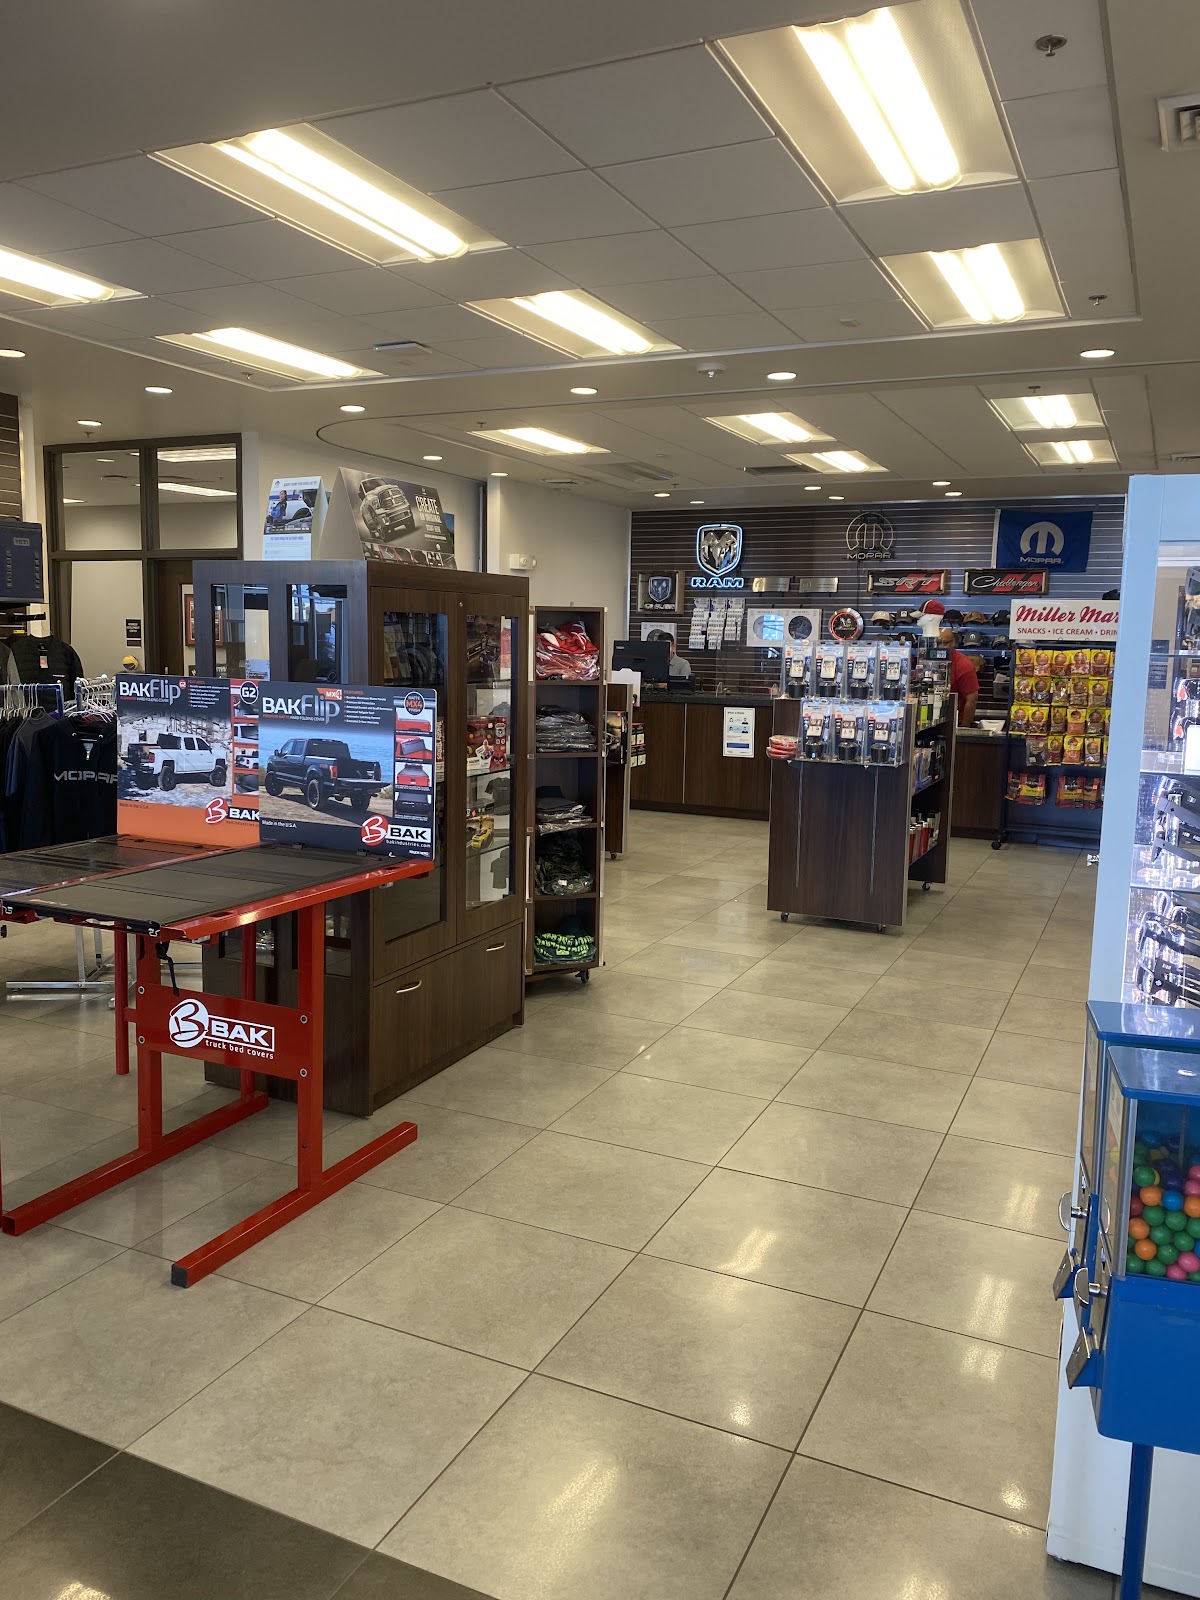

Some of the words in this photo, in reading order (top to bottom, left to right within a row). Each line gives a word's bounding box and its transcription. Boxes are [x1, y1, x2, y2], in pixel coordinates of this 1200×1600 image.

[415, 495, 440, 515] CREATE
[14, 538, 30, 546] YETI
[847, 552, 892, 560] MOPAR
[691, 577, 744, 588] RAM
[873, 577, 939, 589] SRT
[972, 575, 1039, 589] Challenger
[1015, 605, 1076, 622] Miller
[1079, 606, 1119, 623] Mar
[119, 679, 181, 706] BAKFlip
[241, 687, 256, 698] G2
[325, 689, 343, 700] MX4
[262, 694, 340, 724] BAKFlip
[405, 699, 423, 709] MX4
[390, 827, 427, 840] BAK
[386, 840, 431, 848] bakindustries.com
[211, 1020, 269, 1047] BAK
[205, 1039, 227, 1050] truck
[229, 1043, 245, 1054] bed
[247, 1047, 274, 1060] covers
